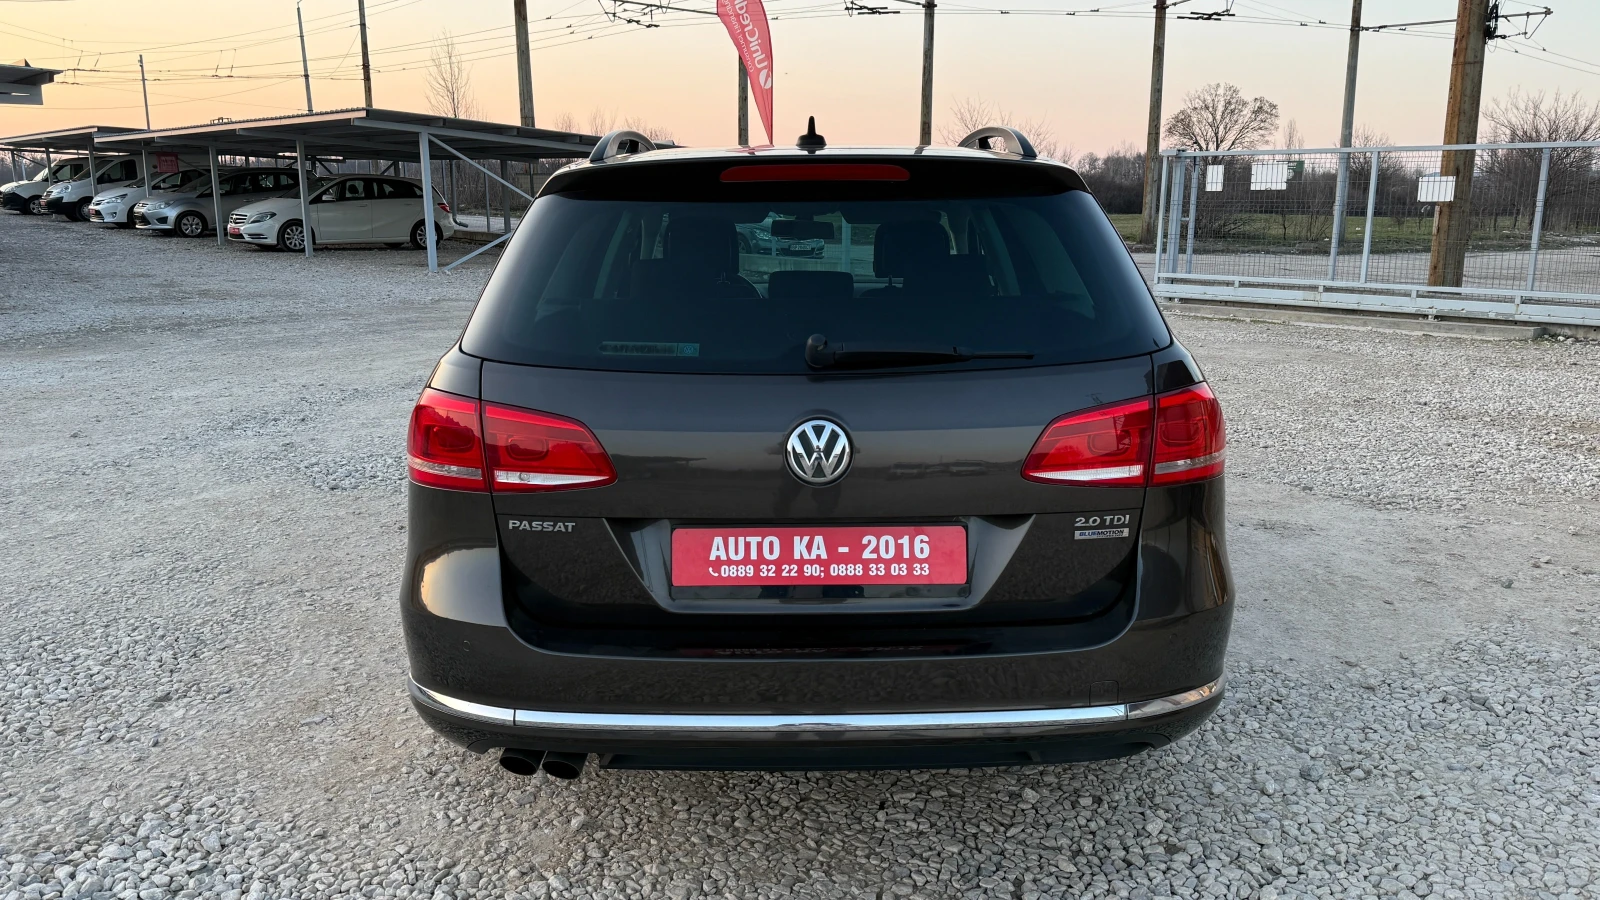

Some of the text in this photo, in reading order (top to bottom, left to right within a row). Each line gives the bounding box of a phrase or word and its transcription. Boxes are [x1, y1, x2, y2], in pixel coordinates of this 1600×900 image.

[508, 520, 575, 532] PASSAT
[1074, 514, 1130, 527] 2.0 TDI
[709, 536, 781, 561] AUTO
[793, 535, 828, 560] KA
[861, 534, 930, 559] 2016
[720, 563, 930, 578] 0889 32 22 90; 0888 33 03 33
